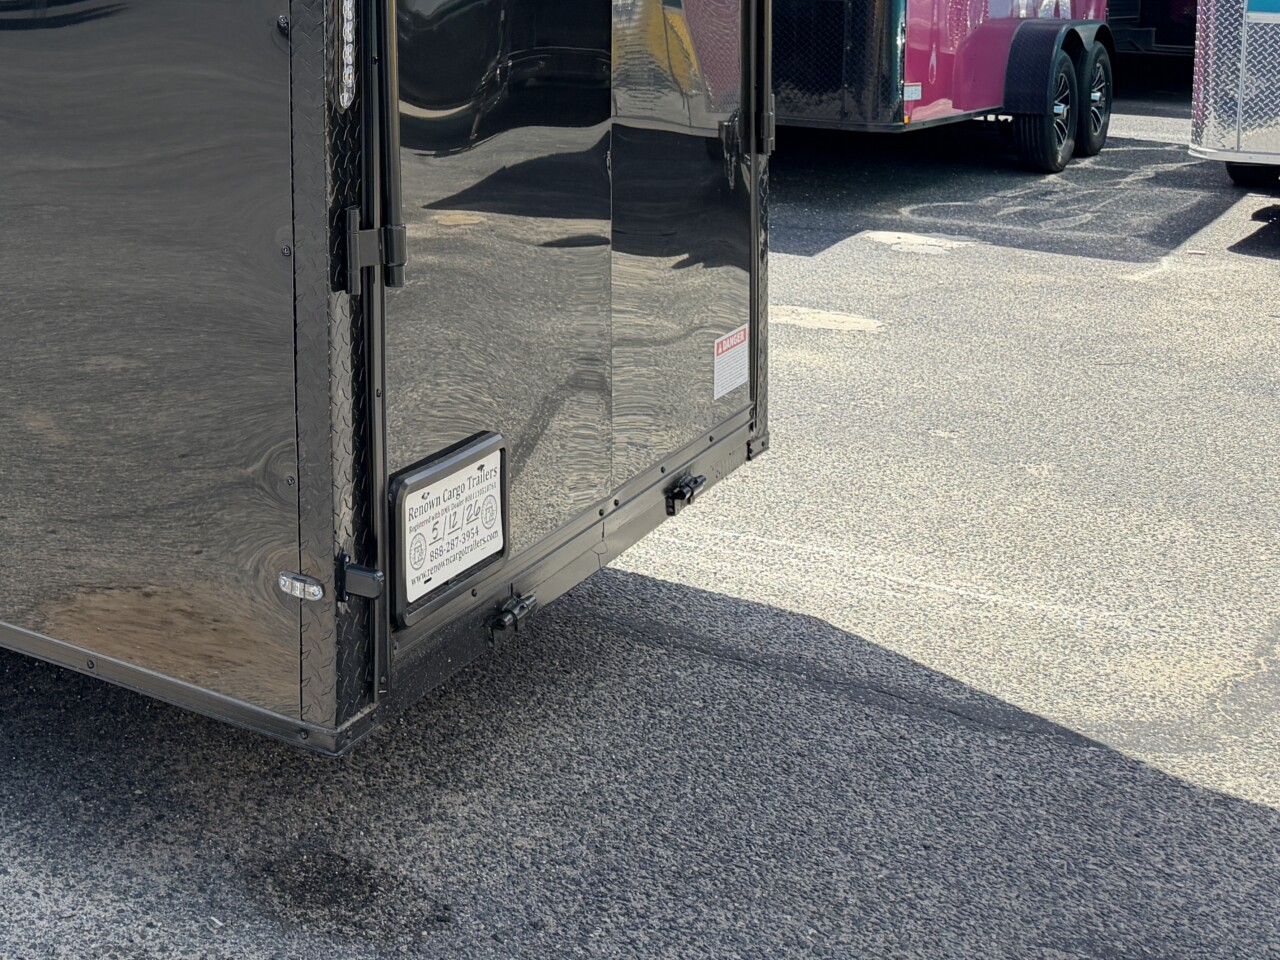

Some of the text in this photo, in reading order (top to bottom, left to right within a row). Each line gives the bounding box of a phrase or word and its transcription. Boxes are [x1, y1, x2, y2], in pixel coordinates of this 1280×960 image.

[722, 330, 745, 351] DANGER
[408, 466, 498, 522] Renown Cargo Trailers
[431, 510, 441, 522] with
[411, 529, 499, 586] www.renowncargotrailers.com
[429, 525, 480, 562] 888-287-3954
